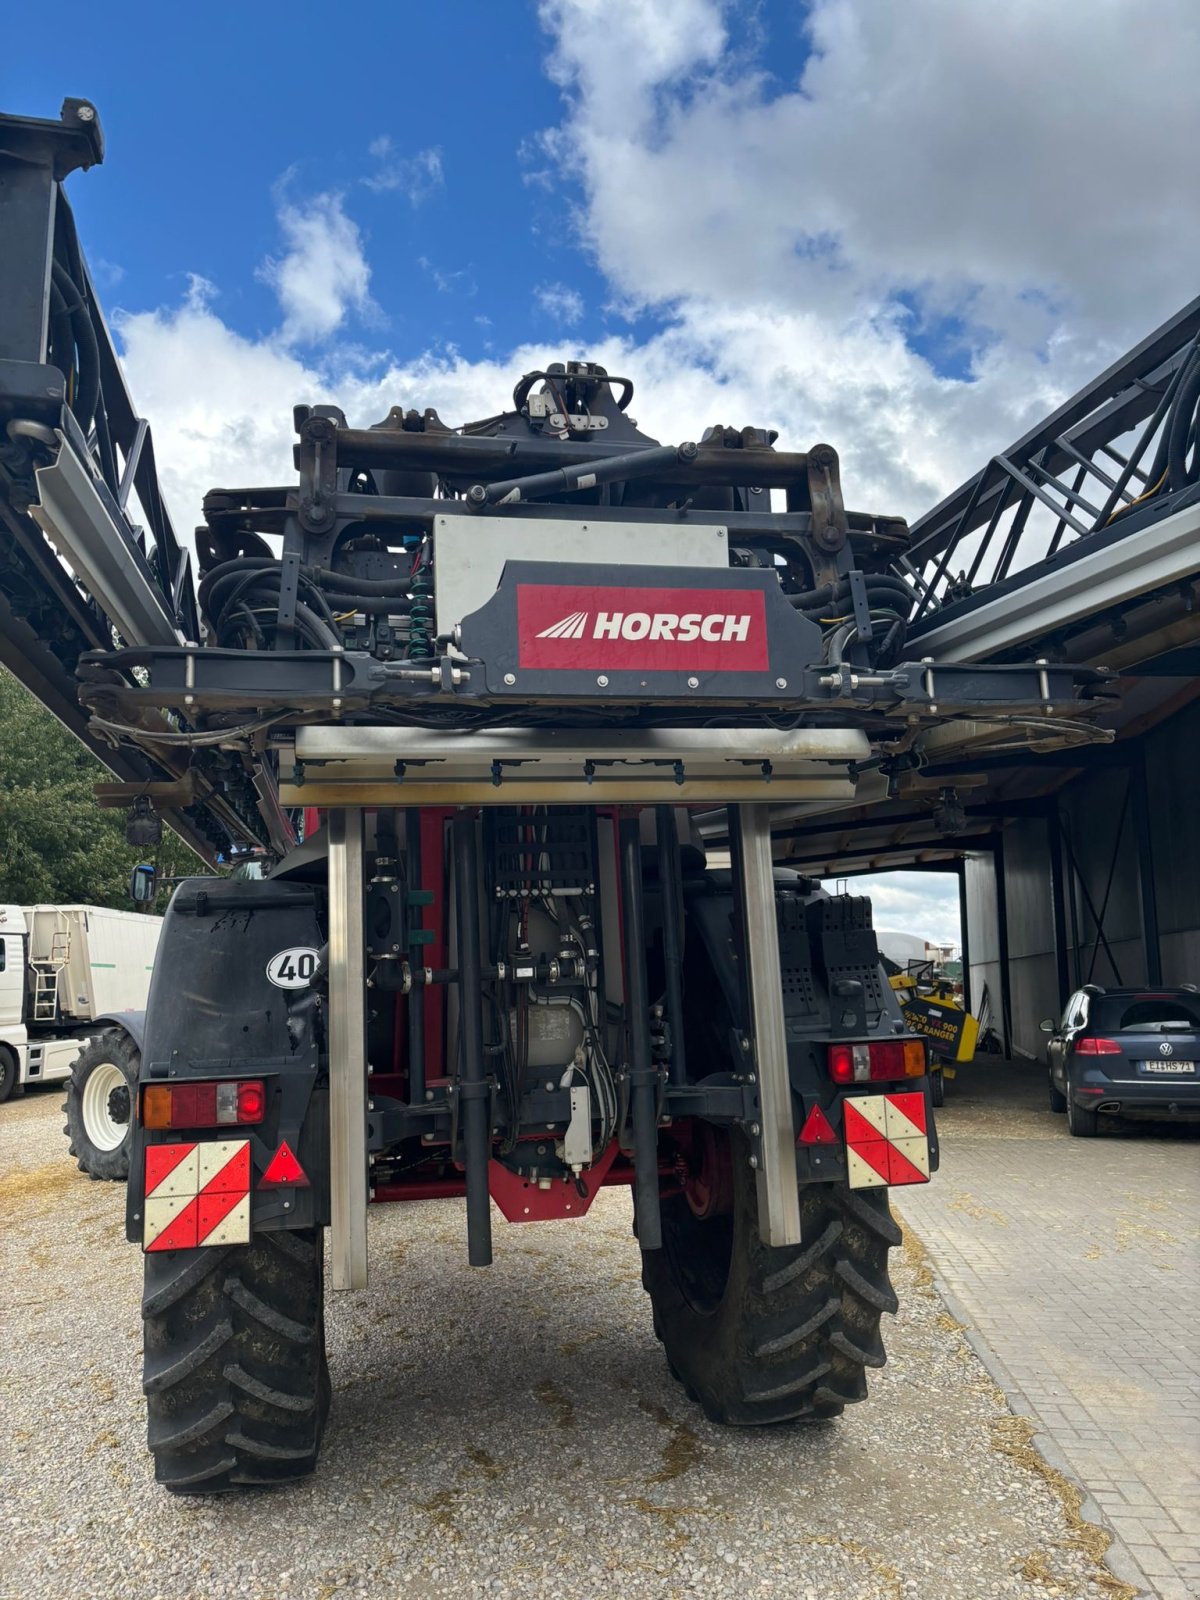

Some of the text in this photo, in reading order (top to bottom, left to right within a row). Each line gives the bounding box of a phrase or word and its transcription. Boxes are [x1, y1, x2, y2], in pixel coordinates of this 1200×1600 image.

[593, 612, 751, 642] HORSCH
[277, 953, 315, 981] 40
[923, 1025, 955, 1042] RANGER
[942, 1022, 958, 1034] 900
